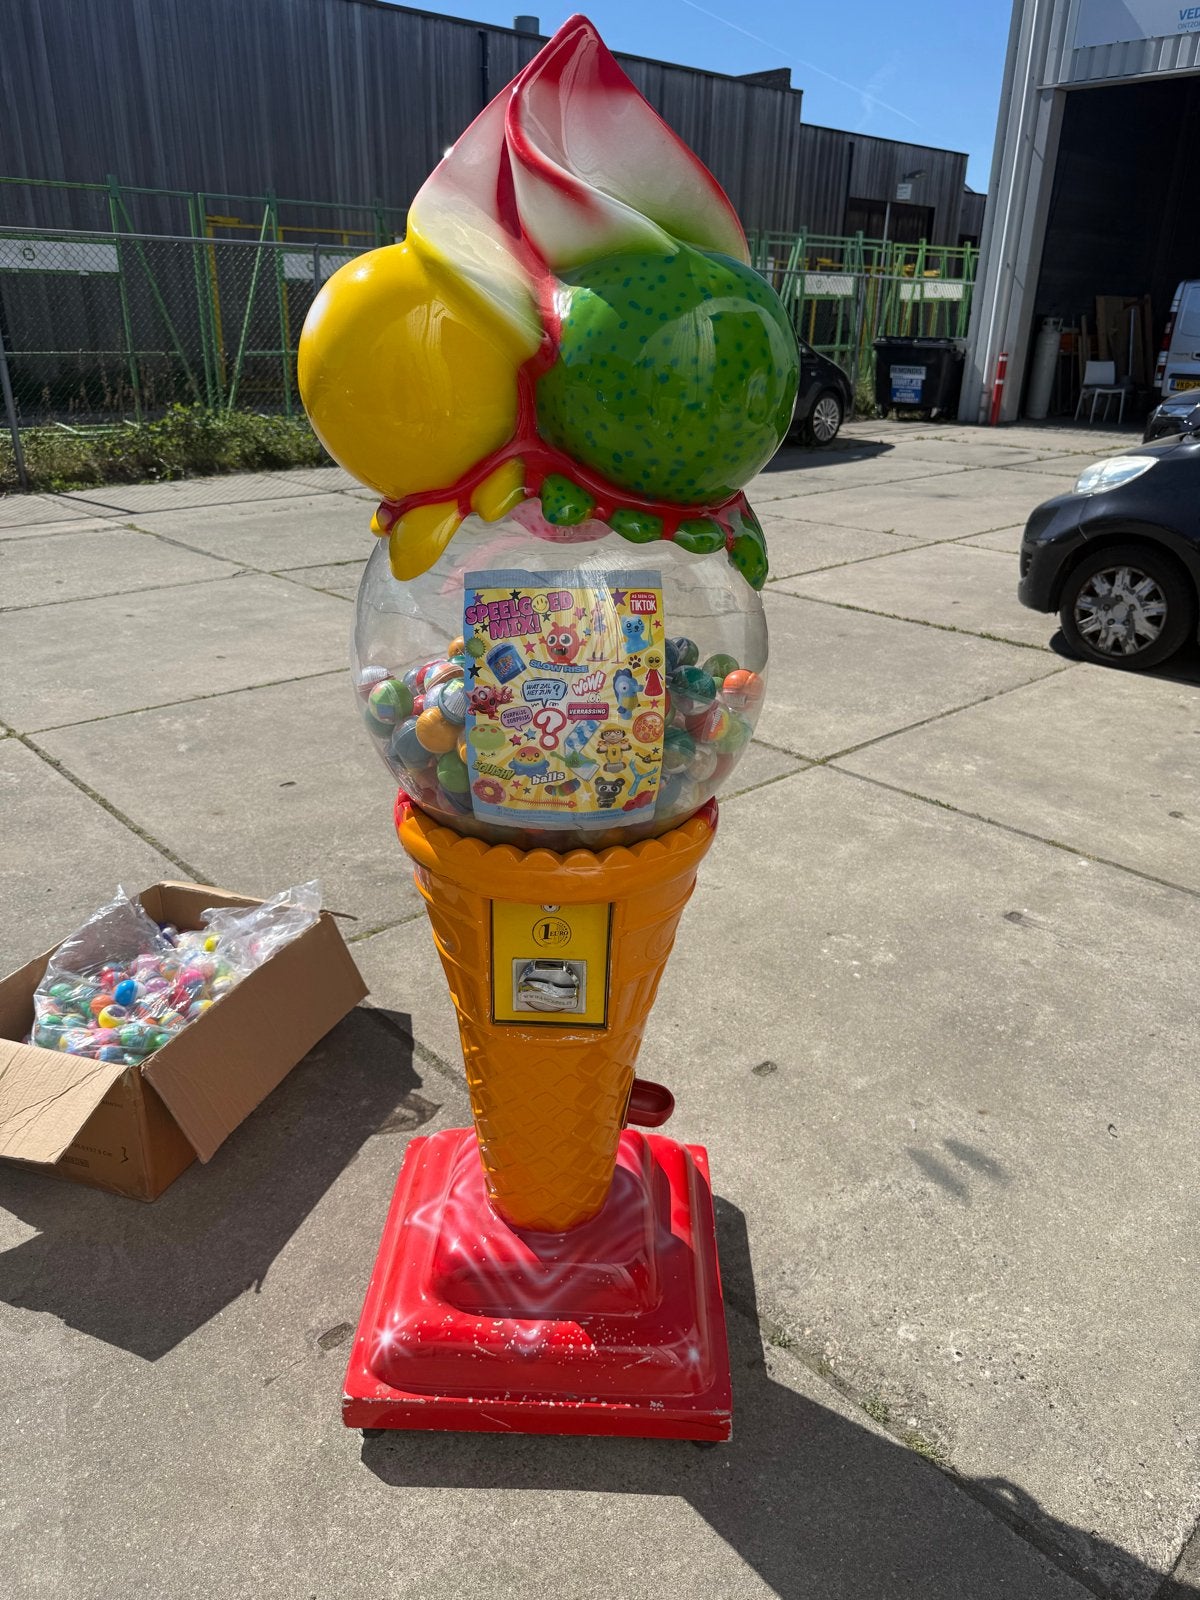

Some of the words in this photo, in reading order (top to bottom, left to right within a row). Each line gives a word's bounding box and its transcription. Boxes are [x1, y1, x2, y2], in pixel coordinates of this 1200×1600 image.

[1177, 21, 1200, 30] ONTZO
[630, 600, 657, 611] TIKTOK
[489, 614, 542, 640] MIX!
[529, 659, 562, 673] SLOW
[563, 664, 589, 674] RISE
[572, 670, 607, 697] WOW!
[473, 760, 516, 781] SQUISHY
[531, 771, 566, 786] balls
